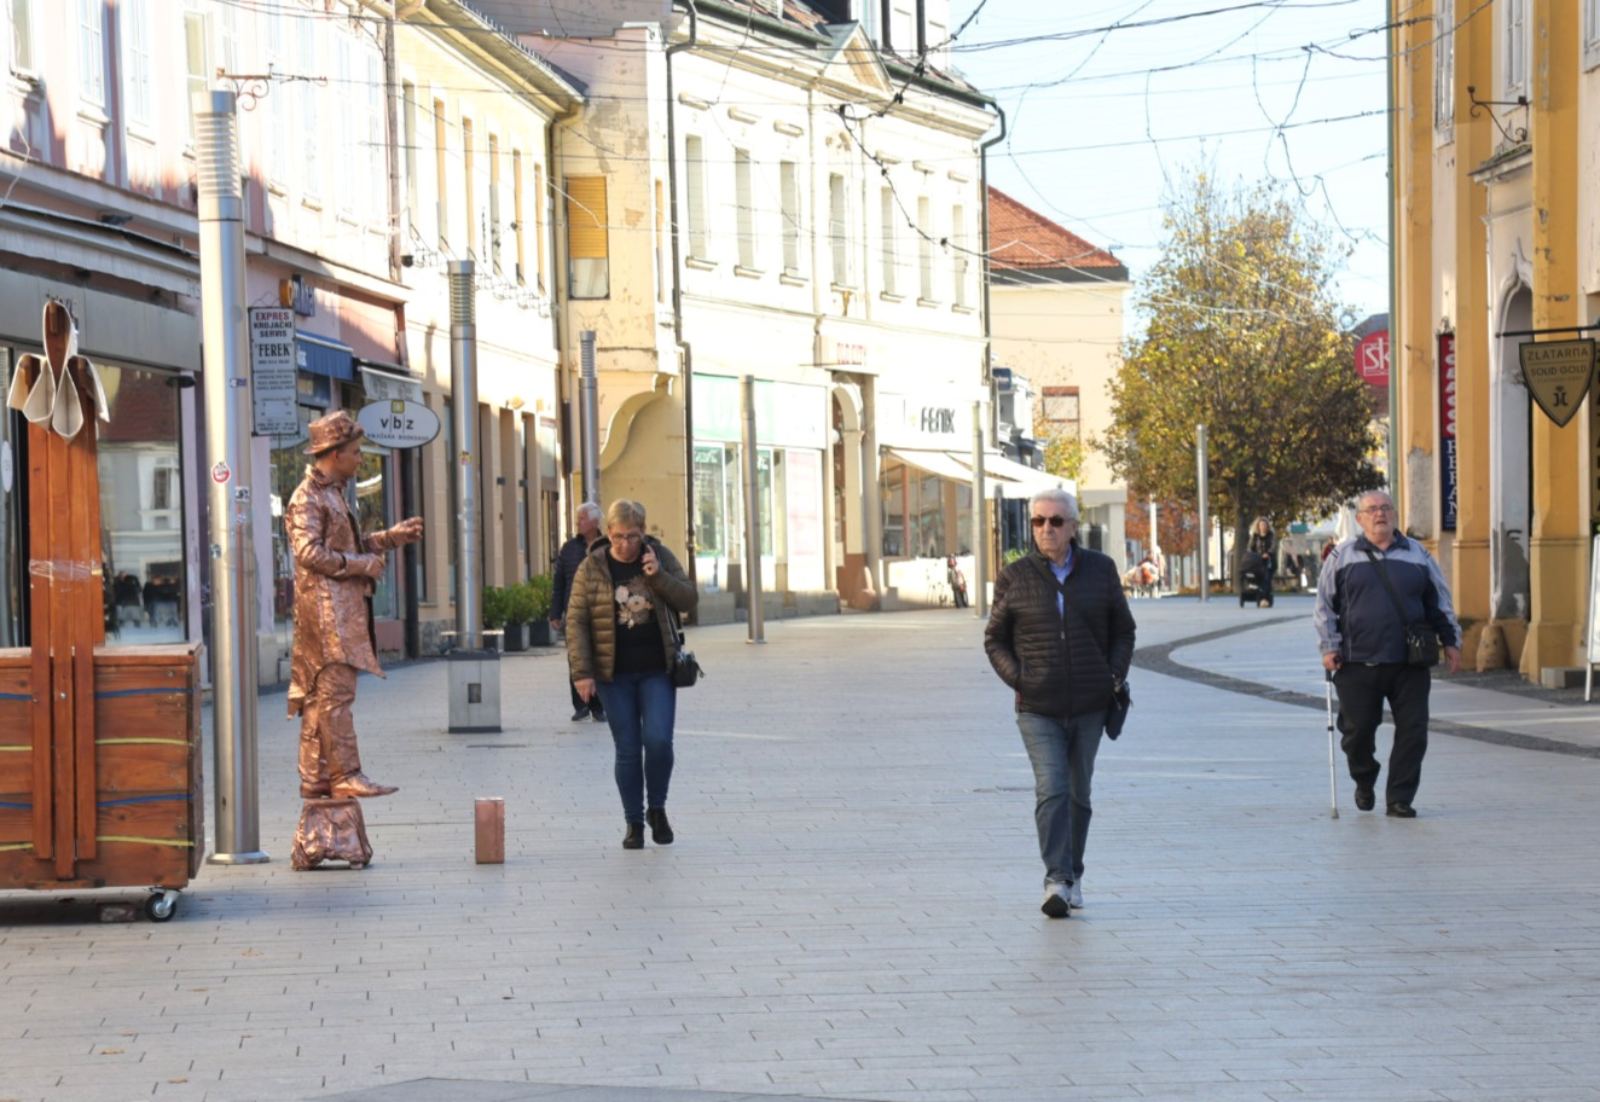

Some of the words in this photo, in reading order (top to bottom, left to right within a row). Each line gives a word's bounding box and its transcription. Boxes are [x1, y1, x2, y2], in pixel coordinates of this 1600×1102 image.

[255, 311, 290, 321] EXPRES
[1526, 346, 1589, 361] ZLATARNA
[1559, 364, 1586, 375] GOLD
[920, 406, 956, 434] FENIX
